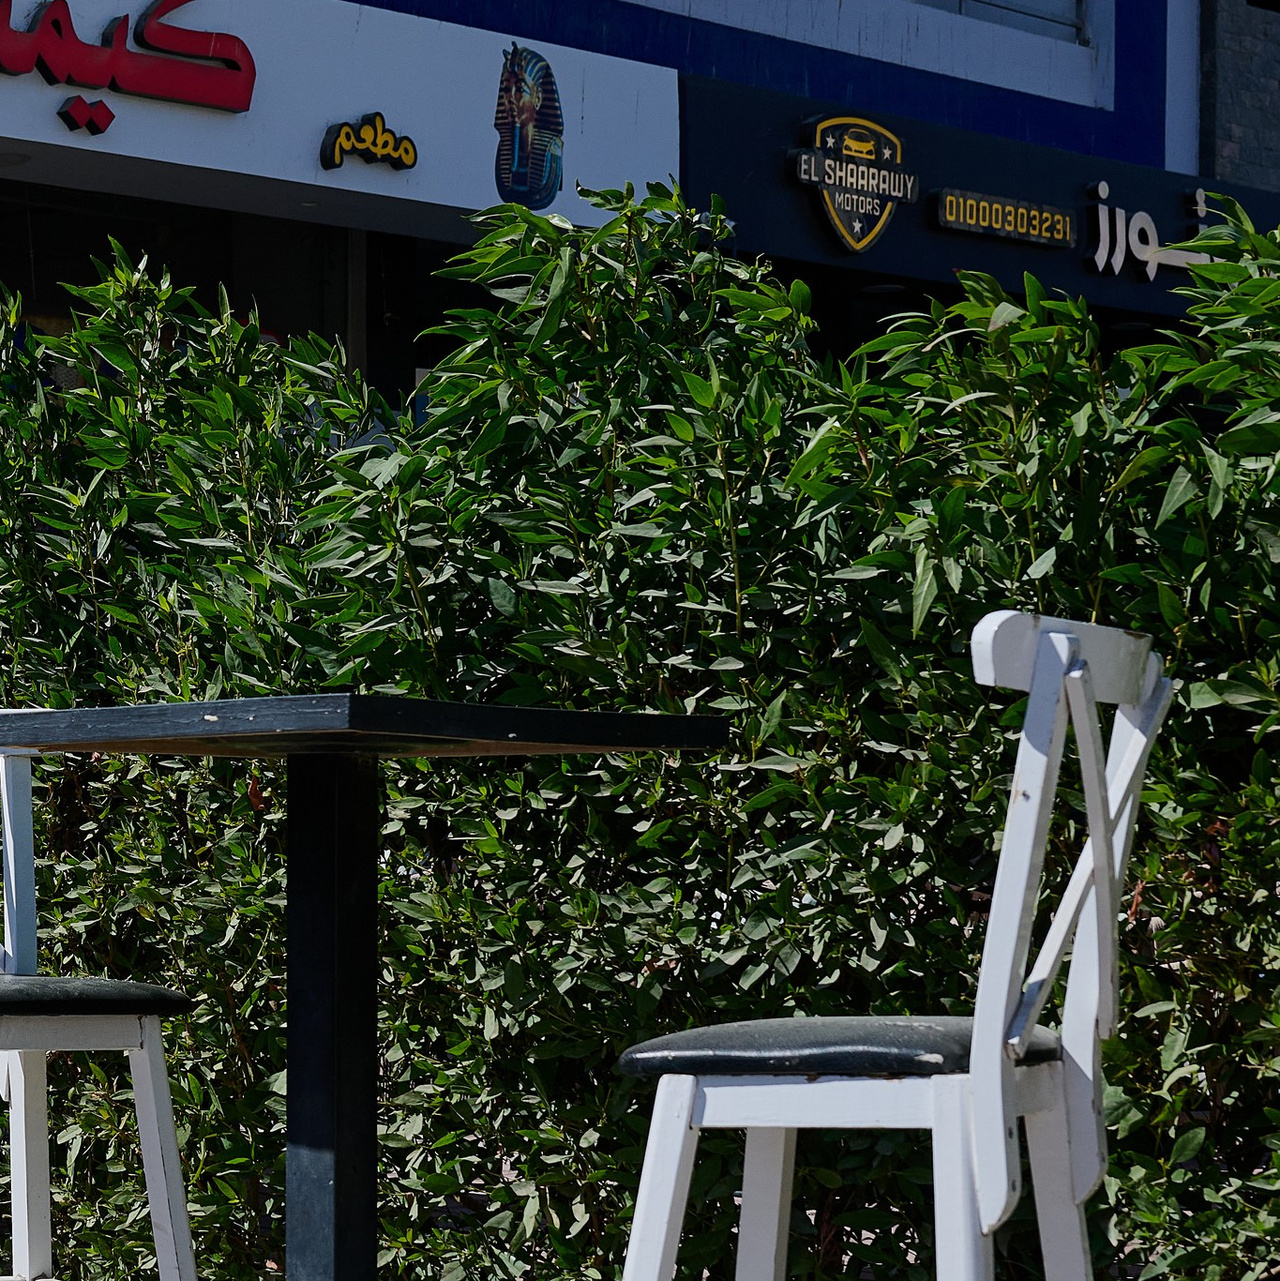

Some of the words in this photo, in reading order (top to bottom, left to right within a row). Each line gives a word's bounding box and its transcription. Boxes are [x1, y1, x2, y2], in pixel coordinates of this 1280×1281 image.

[329, 113, 417, 168] مطعم
[800, 154, 820, 182] EL
[824, 159, 916, 200] SHAARAWY
[835, 192, 881, 216] MOTORS
[945, 194, 1071, 241] 01000303231
